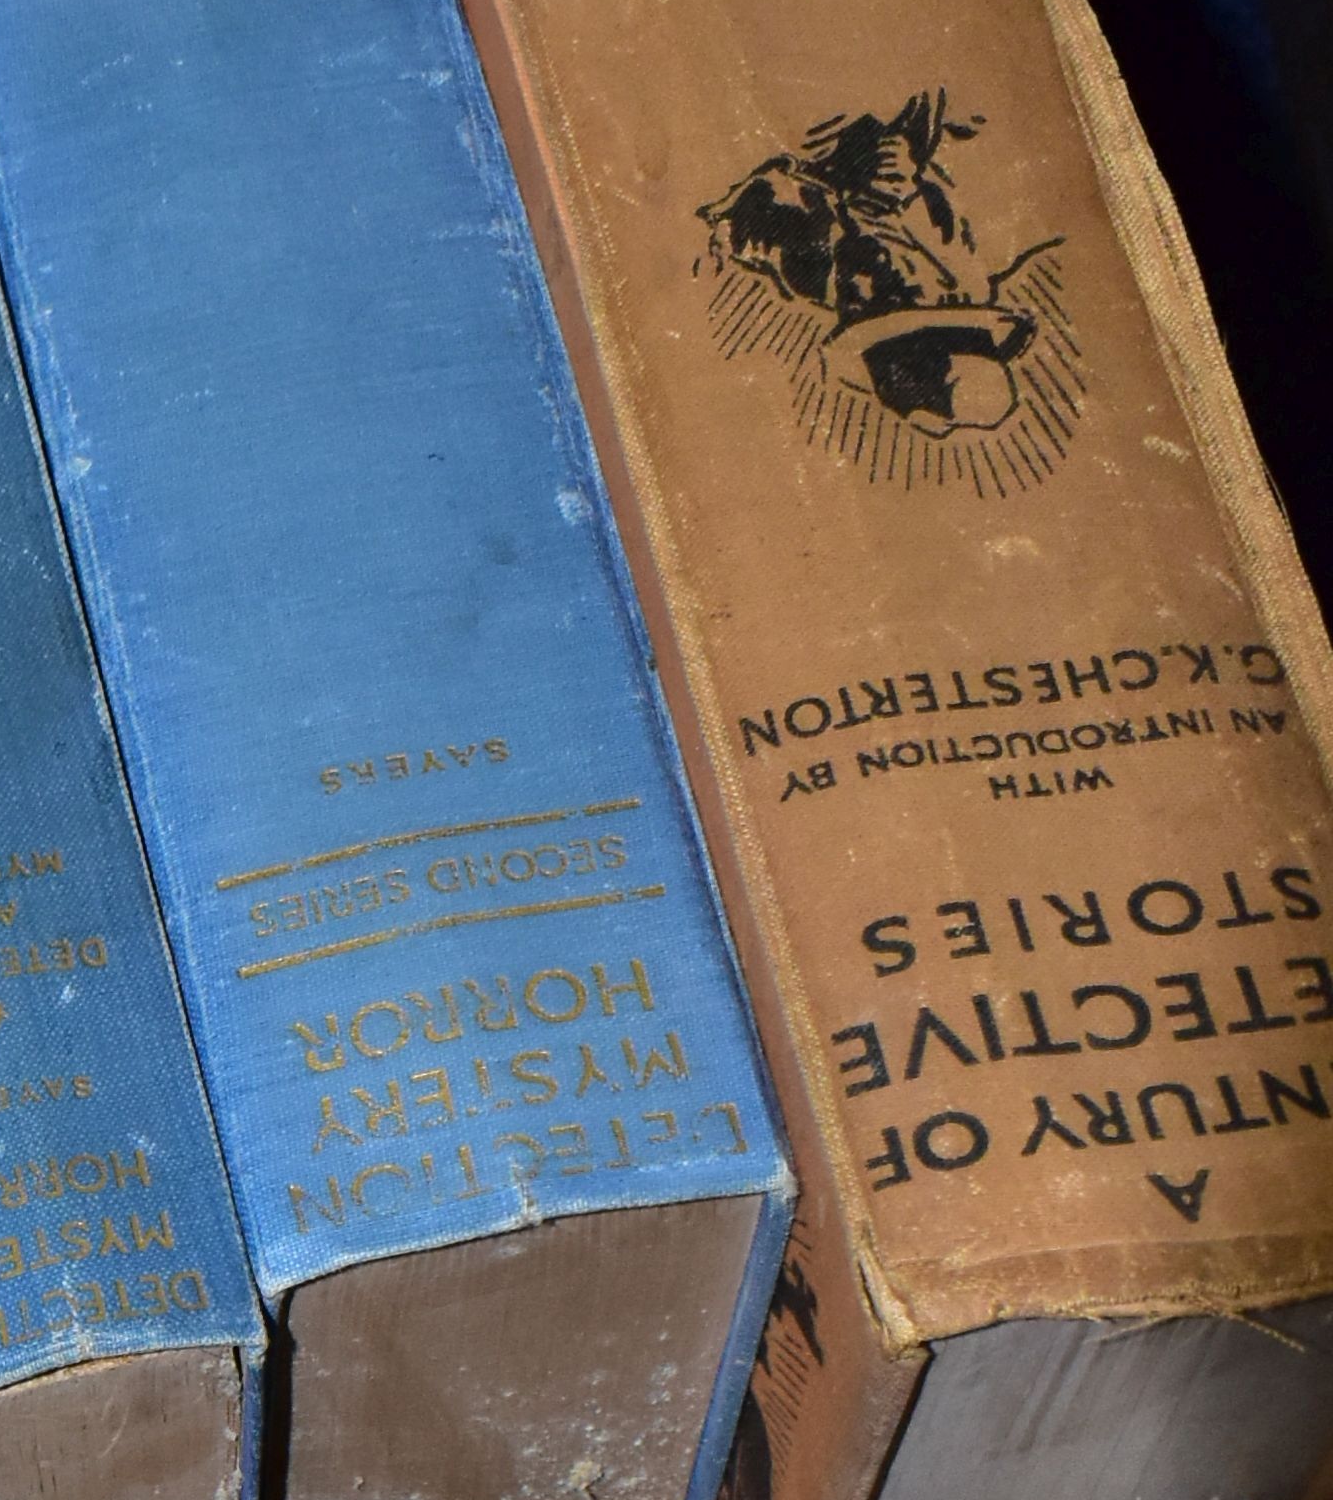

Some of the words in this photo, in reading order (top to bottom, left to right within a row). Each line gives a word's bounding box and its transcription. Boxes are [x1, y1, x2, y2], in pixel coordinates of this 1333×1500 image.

[857, 708, 1215, 780] INTRODUCTION
[1231, 706, 1288, 736] AN
[318, 736, 511, 797] SAYERS
[779, 760, 836, 803] BY
[986, 766, 1115, 801] WITH
[425, 830, 627, 905] SECOND
[245, 868, 413, 940] SERIES
[859, 864, 1315, 980] STORIES
[287, 955, 656, 1074] HORROR
[310, 1028, 691, 1155] MYSTERY
[287, 1097, 750, 1237] DETECTION
[1146, 1168, 1212, 1226] A
